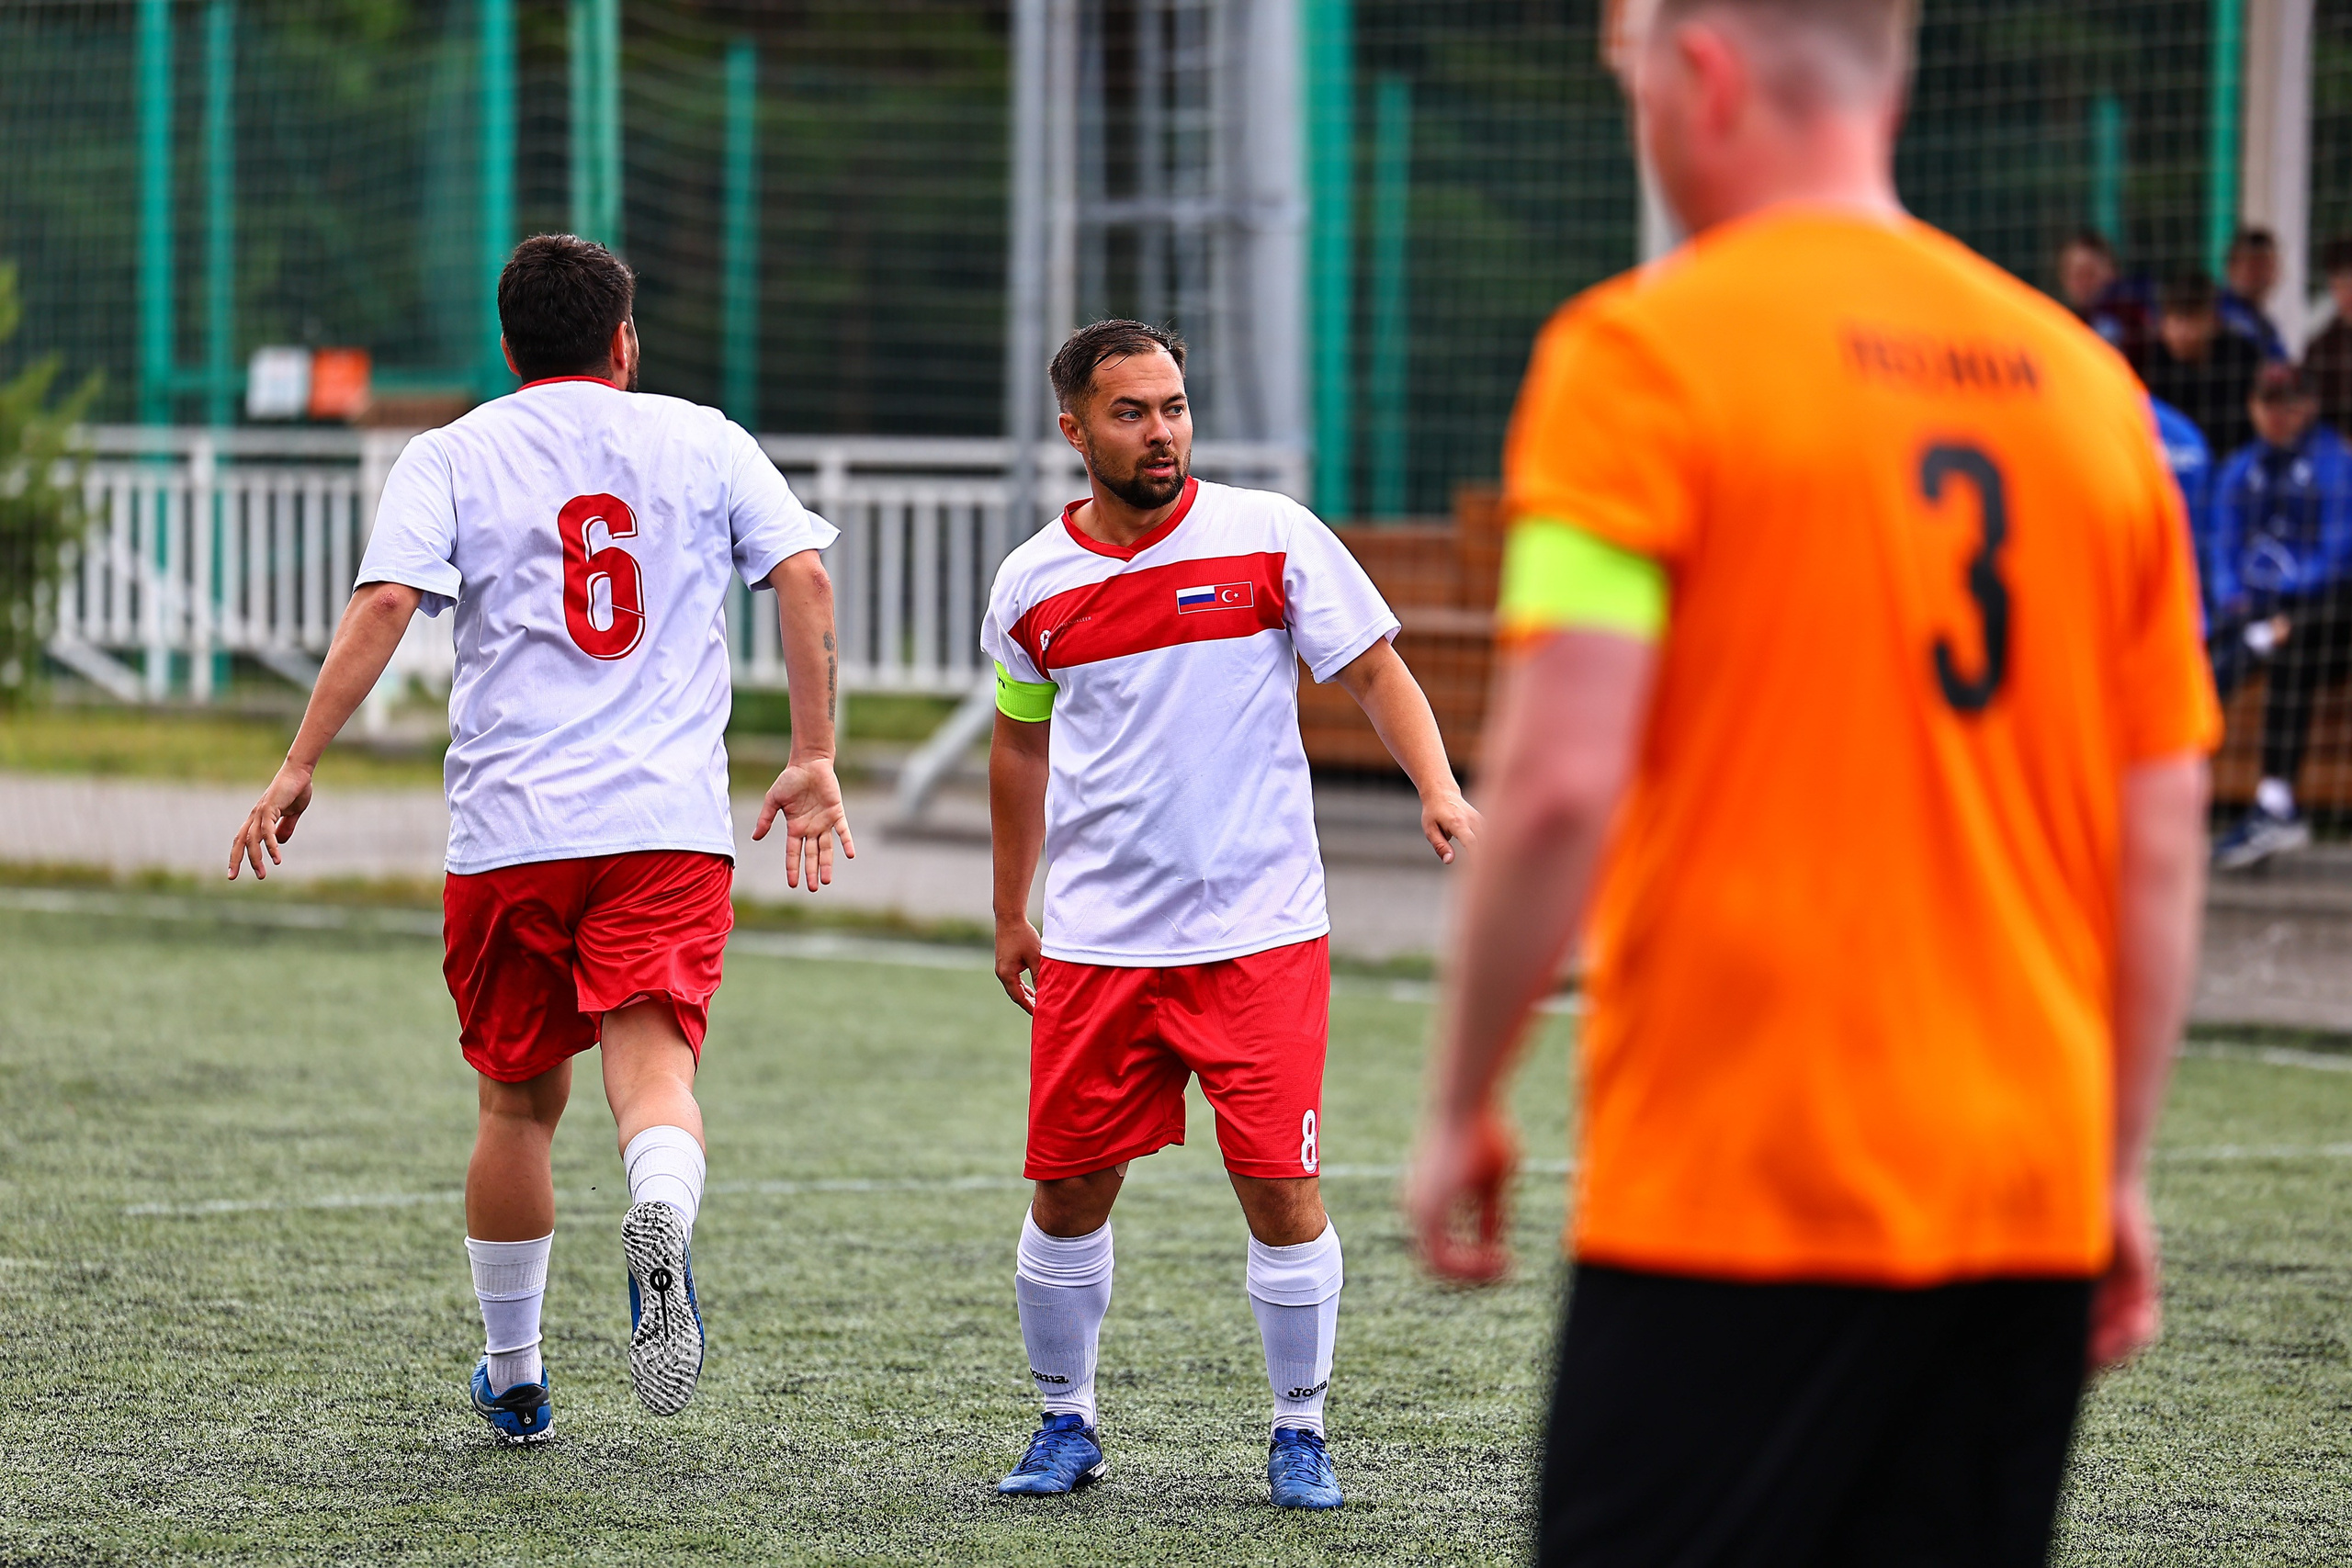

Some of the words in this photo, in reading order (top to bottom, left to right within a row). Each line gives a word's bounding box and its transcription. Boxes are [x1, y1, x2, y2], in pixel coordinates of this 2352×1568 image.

[557, 492, 645, 660] 6
[1921, 445, 2008, 713] 3
[1300, 1109, 1318, 1174] 8
